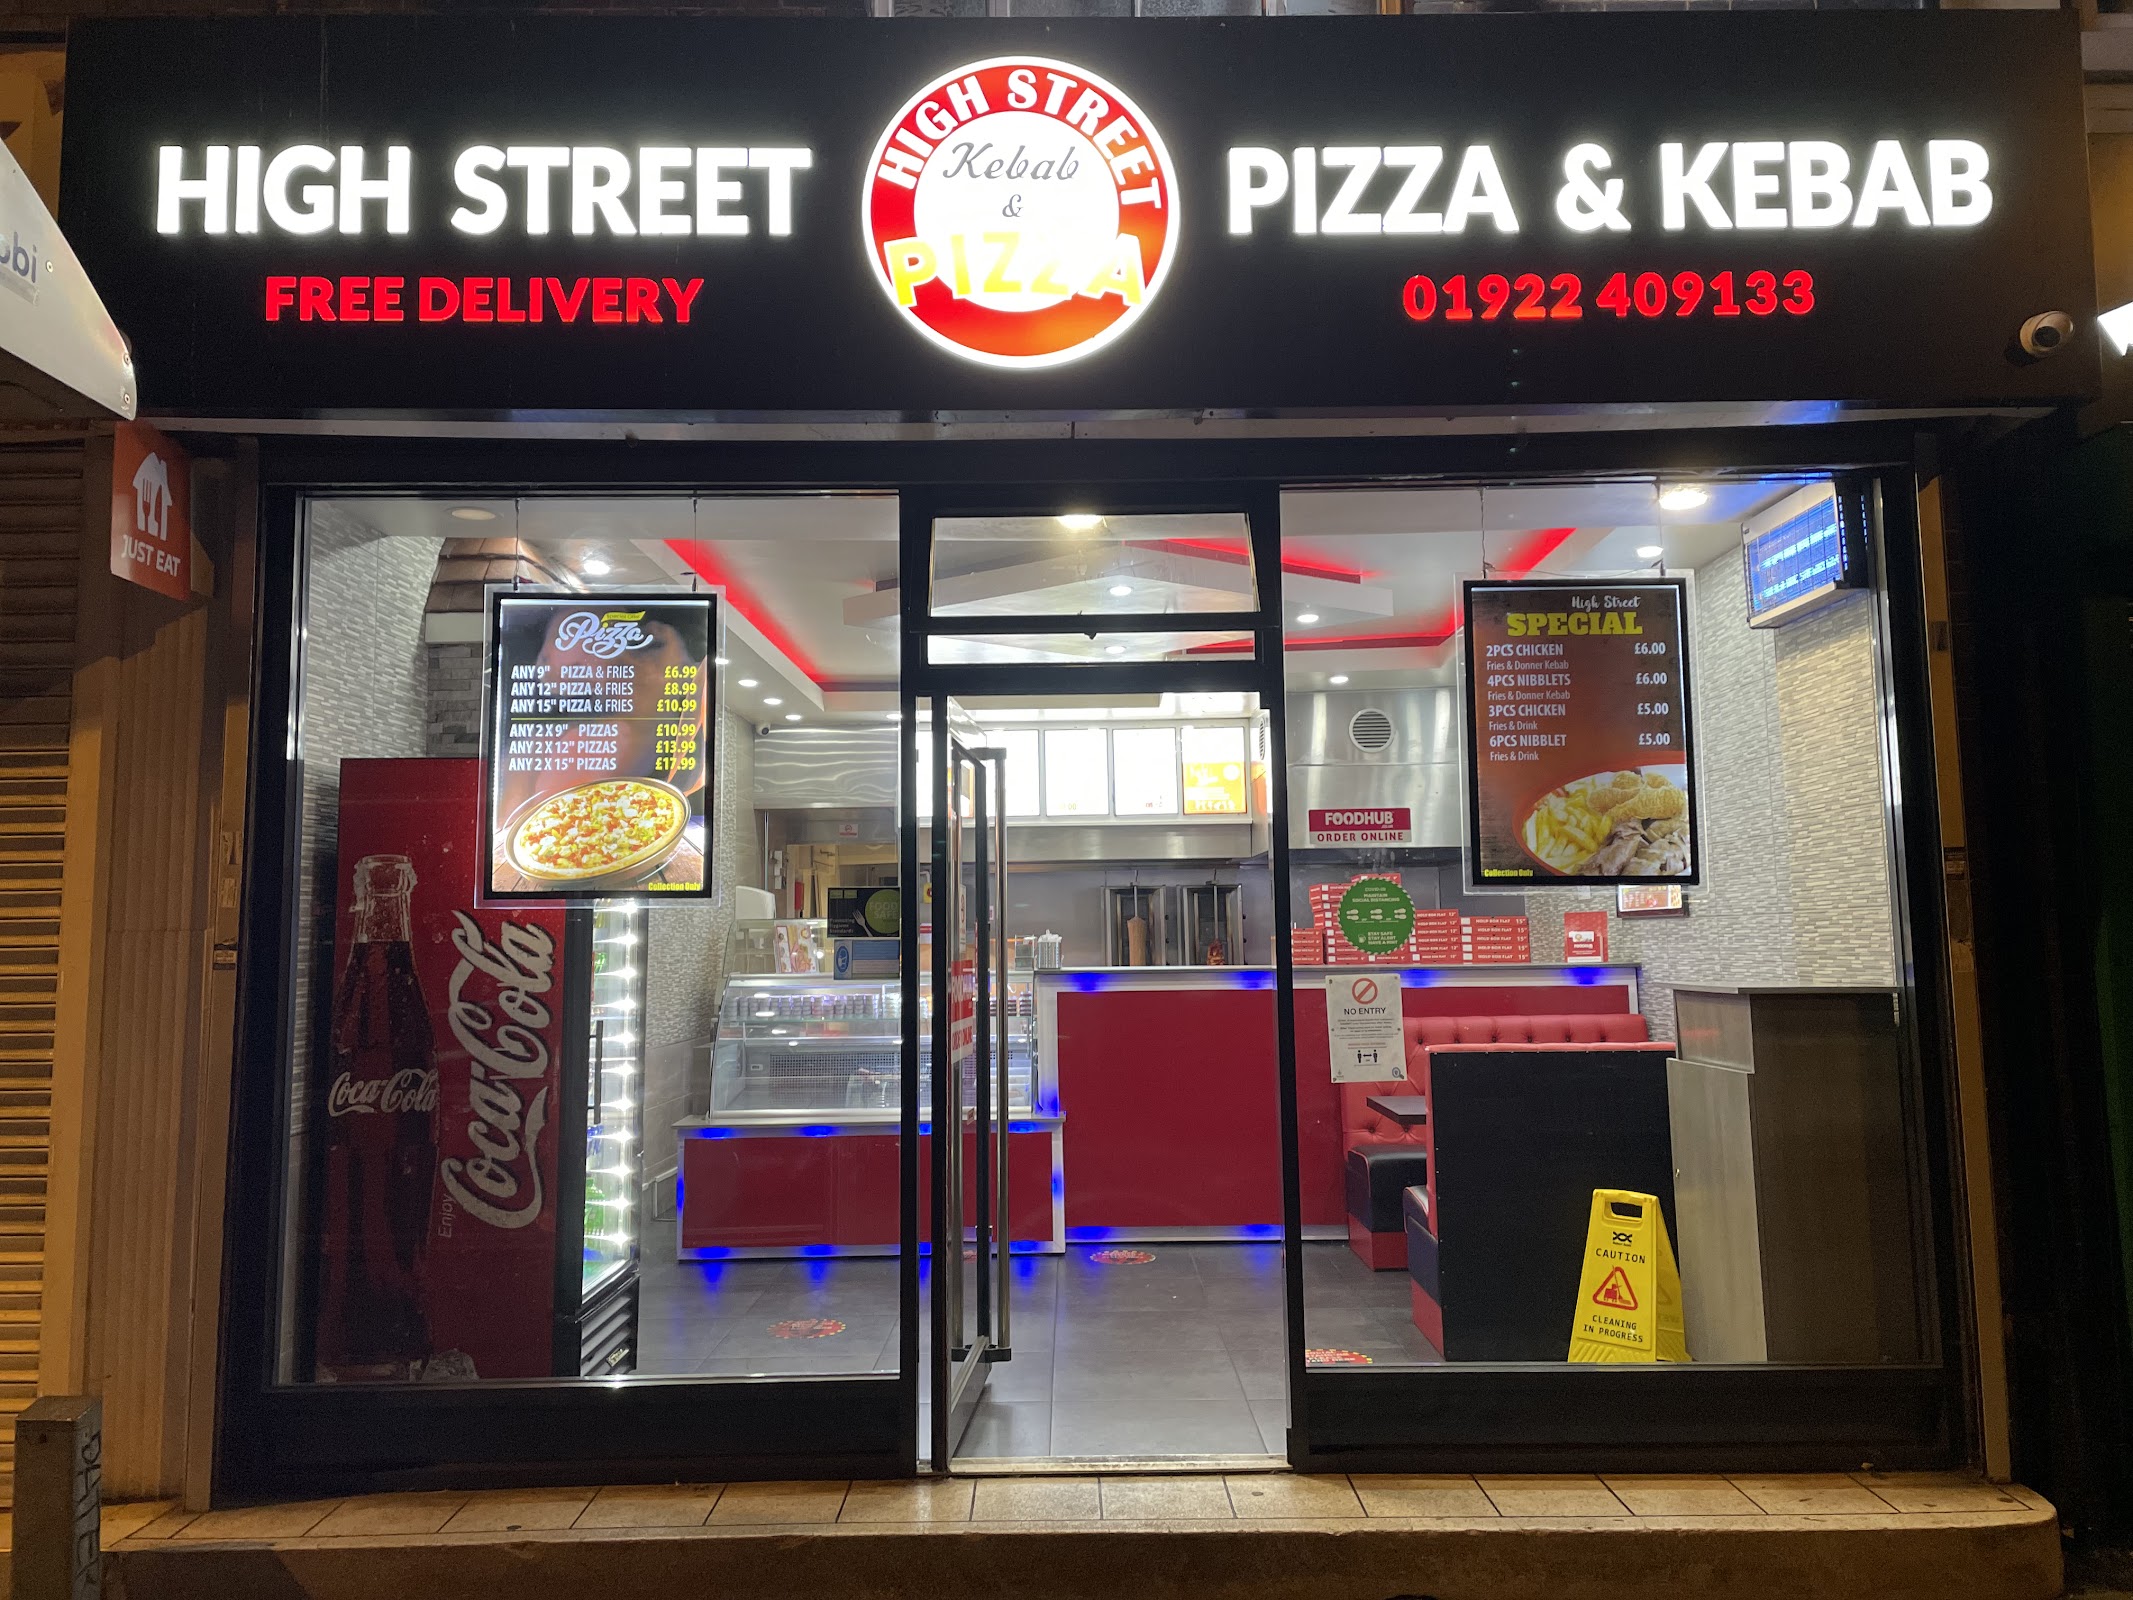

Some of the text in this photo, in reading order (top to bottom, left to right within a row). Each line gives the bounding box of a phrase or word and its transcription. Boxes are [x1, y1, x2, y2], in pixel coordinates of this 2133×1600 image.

[877, 69, 1161, 209] HIGH STREET
[942, 142, 1079, 181] Kebab
[156, 144, 813, 238] HIGH STREET
[1227, 139, 1993, 237] PIZZA & KEBAB
[1001, 194, 1024, 218] &
[884, 231, 1143, 307] PIZZA
[265, 277, 704, 325] FREE DELIVERY
[1402, 269, 1816, 321] 01922 409133
[121, 534, 181, 577] JUST EAT
[1571, 595, 1641, 612] High Street
[1507, 612, 1643, 636] SPECIAL
[555, 611, 654, 659] Pizza
[1486, 642, 1666, 657] 2PCS CHICKEN £6.00
[511, 665, 697, 680] ANY 9" PIZZA & FRIES £6.99
[1487, 660, 1569, 670] Fries & Donner Kebab
[1487, 672, 1667, 687] 4PCS NIBBLETS £6.00
[511, 682, 697, 696] ANY 12" PIZZA & FRIES £8.99
[1488, 690, 1570, 700] Fries & Donner Kebab
[510, 699, 697, 713] ANY 15" PIZZA & FRIES £10.99
[1489, 703, 1669, 717] 3PCS CHICKEN £5.00
[509, 724, 696, 738] ANY 2 X 9" PIZZAS £10.99
[1489, 721, 1538, 730] Fries & Drink
[509, 740, 696, 755] ANY 2 X 12" PIZZAS £13.99
[1490, 733, 1670, 747] 6PCS NIBBLET £5.00
[1490, 751, 1539, 761] Fries & Drink
[508, 757, 696, 771] ANY 2 X 15" PIZZAS £17.99
[1325, 811, 1394, 825] FOODHUB
[1317, 832, 1403, 841] ORDER ONLINE
[1484, 869, 1533, 878] Collection Only
[648, 882, 701, 891] Collection Only
[1359, 1007, 1386, 1015] ENTRY
[441, 910, 555, 1229] Coca-Cola
[328, 1068, 438, 1117] Coca-Cola
[438, 1193, 456, 1238] Enjoy
[1595, 1248, 1646, 1264] CAUTION
[1592, 1314, 1637, 1330] CLEANING
[1583, 1324, 1643, 1343] IN PROGRESS
